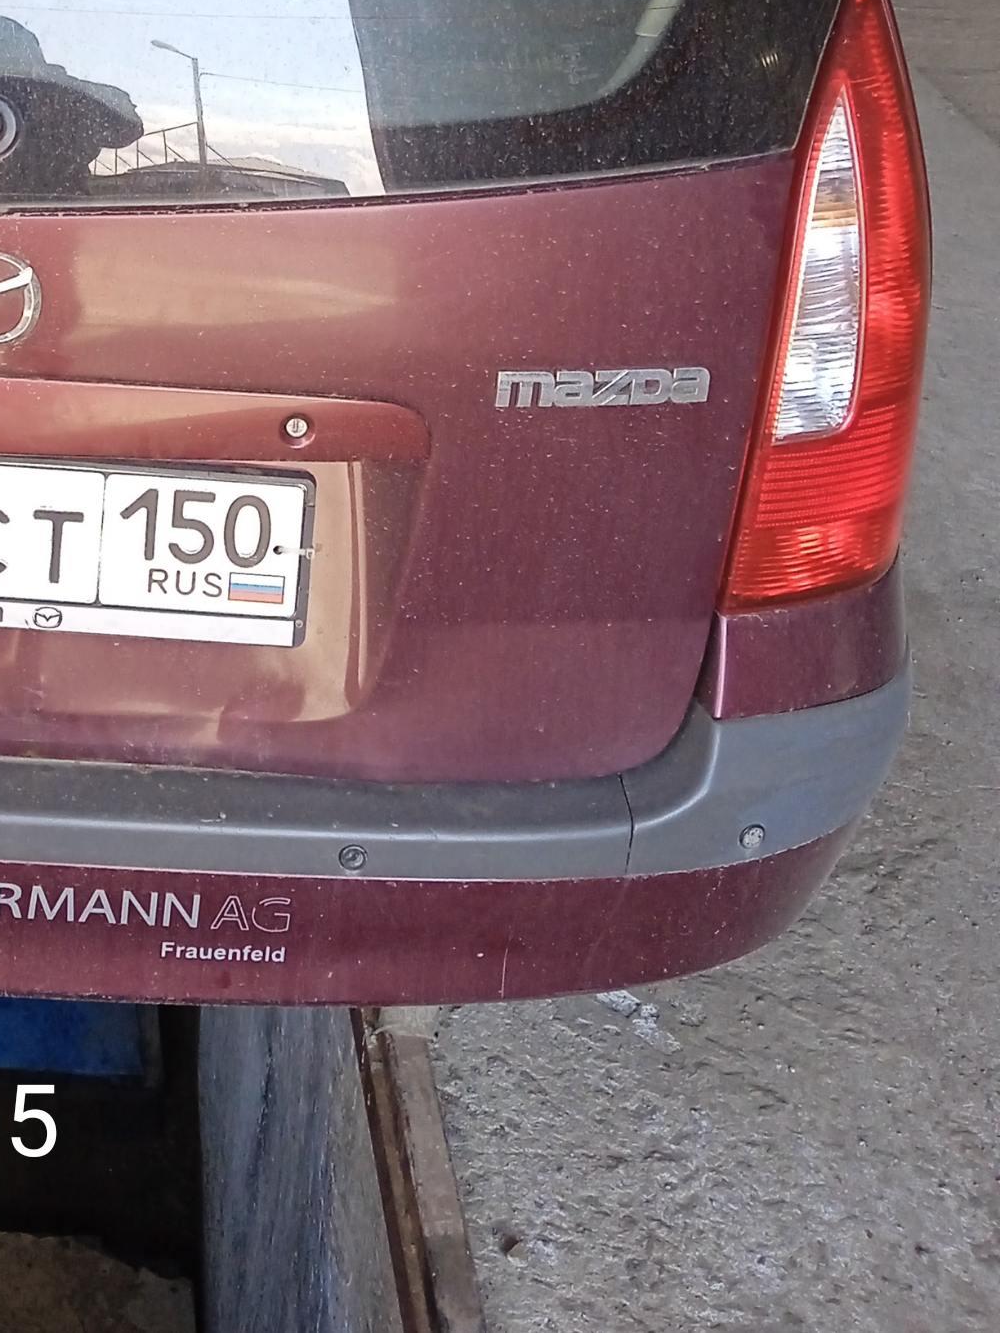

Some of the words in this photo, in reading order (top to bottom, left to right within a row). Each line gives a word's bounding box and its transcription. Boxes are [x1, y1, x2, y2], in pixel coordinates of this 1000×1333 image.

[120, 488, 272, 569] 150
[147, 568, 223, 598] RUS
[210, 895, 292, 933] AG
[160, 940, 287, 964] Frauenfeld
